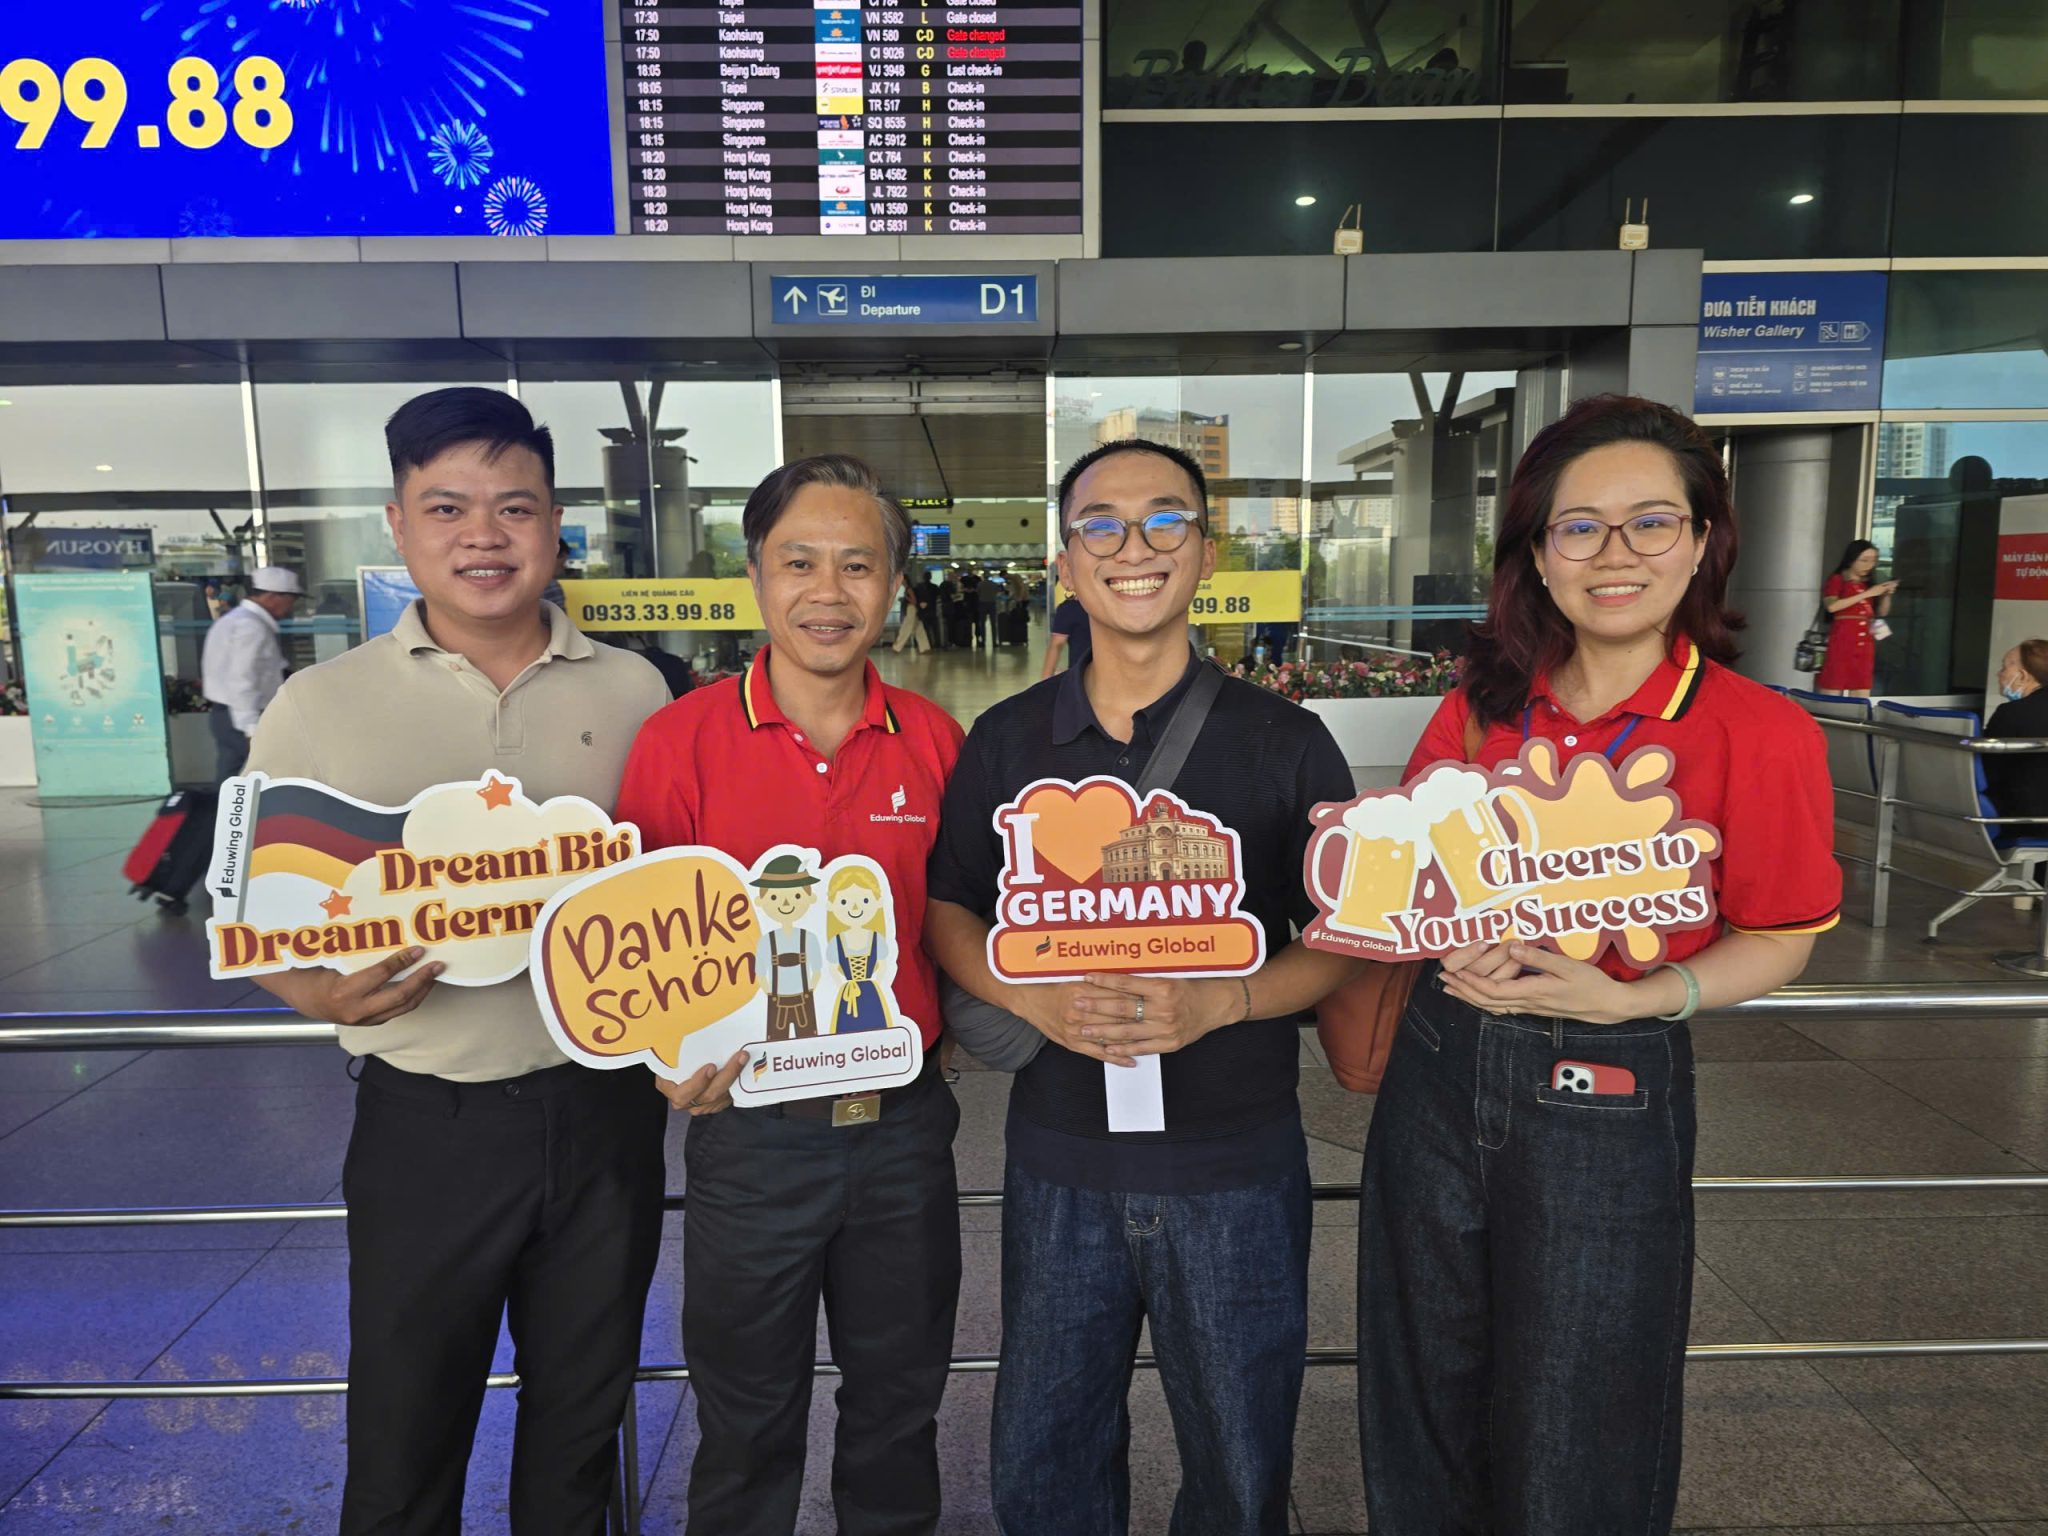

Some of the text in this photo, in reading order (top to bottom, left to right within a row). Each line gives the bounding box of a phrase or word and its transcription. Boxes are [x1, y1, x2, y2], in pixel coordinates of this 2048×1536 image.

[634, 11, 658, 23] 17:30
[718, 11, 744, 26] Taipei
[865, 12, 880, 24] VN
[882, 12, 903, 24] 3582
[922, 12, 928, 24] L
[947, 11, 968, 23] Gate
[969, 11, 996, 23] closed
[635, 29, 659, 41] 17:50
[719, 29, 763, 44] Kaohsiung
[866, 30, 880, 41] VN
[916, 30, 933, 41] C-D
[947, 29, 968, 40] Gate
[969, 30, 1005, 43] changed
[636, 46, 1006, 61] 17:50 Kaohsiung CI 9026 C-D Gate changed
[637, 64, 661, 76] 18:05
[720, 64, 749, 79] Beijing
[751, 64, 779, 79] Daxing
[869, 65, 881, 76] VJ
[884, 65, 905, 76] 3948
[922, 65, 929, 76] G
[947, 64, 965, 76] Last
[967, 64, 1002, 76] check-in
[638, 81, 984, 96] 18:05 Taipei JX 714 B Check-in
[0, 56, 294, 149] 99.88
[639, 99, 984, 114] 18:15 Singapore TR 517 H Check-in
[640, 116, 985, 131] 18:15 Singapore SQ 8535 H Check-in
[640, 134, 664, 146] 18:15
[723, 134, 765, 148] Singapore
[869, 134, 882, 146] AC
[885, 134, 906, 146] 5912
[923, 135, 930, 145] H
[948, 134, 985, 145] Check-in
[641, 151, 665, 163] 18:20
[724, 151, 746, 165] Hong
[748, 151, 770, 166] Kong
[869, 151, 883, 163] CX
[924, 151, 931, 163] K
[949, 151, 985, 163] Check-in
[642, 168, 665, 180] 18:20
[725, 168, 747, 183] Hong
[748, 168, 771, 183] Kong
[870, 169, 883, 180] BA
[924, 169, 931, 180] K
[949, 168, 985, 180] Check-in
[643, 185, 986, 200] 18:20 Hong Kong JL 7922 K Check-in
[644, 203, 667, 214] 18:20
[726, 203, 748, 217] Hong
[750, 203, 772, 217] Kong
[871, 203, 884, 214] VN
[925, 203, 932, 214] K
[950, 202, 986, 214] Check-in
[644, 219, 668, 231] 18:20
[727, 220, 749, 234] Hong
[750, 220, 773, 234] Kong
[870, 220, 885, 232] QR
[925, 220, 932, 231] K
[950, 219, 986, 231] Check-in
[861, 286, 876, 298] ĐI
[980, 284, 1024, 314] D1
[861, 304, 921, 318] Departure
[1704, 296, 1817, 317] ĐƯA TIỄN KHÁCH
[1704, 325, 1805, 339] Wisher Gallery
[583, 604, 735, 621] 0933.33.99.88
[870, 814, 926, 823] Eduwing Global
[222, 784, 246, 885] Eduwing Global
[1004, 813, 1045, 885] I
[382, 846, 549, 892] Dream
[1478, 834, 1698, 889] Cheers to
[1007, 883, 1233, 926] GERMANY
[563, 869, 751, 984] Danke
[1385, 888, 1706, 952] Your Success
[218, 918, 400, 969] Dream
[1057, 936, 1215, 960] Eduwing Global
[1321, 932, 1394, 953] Eduwing Global
[772, 1041, 906, 1073] Eduwing Global
